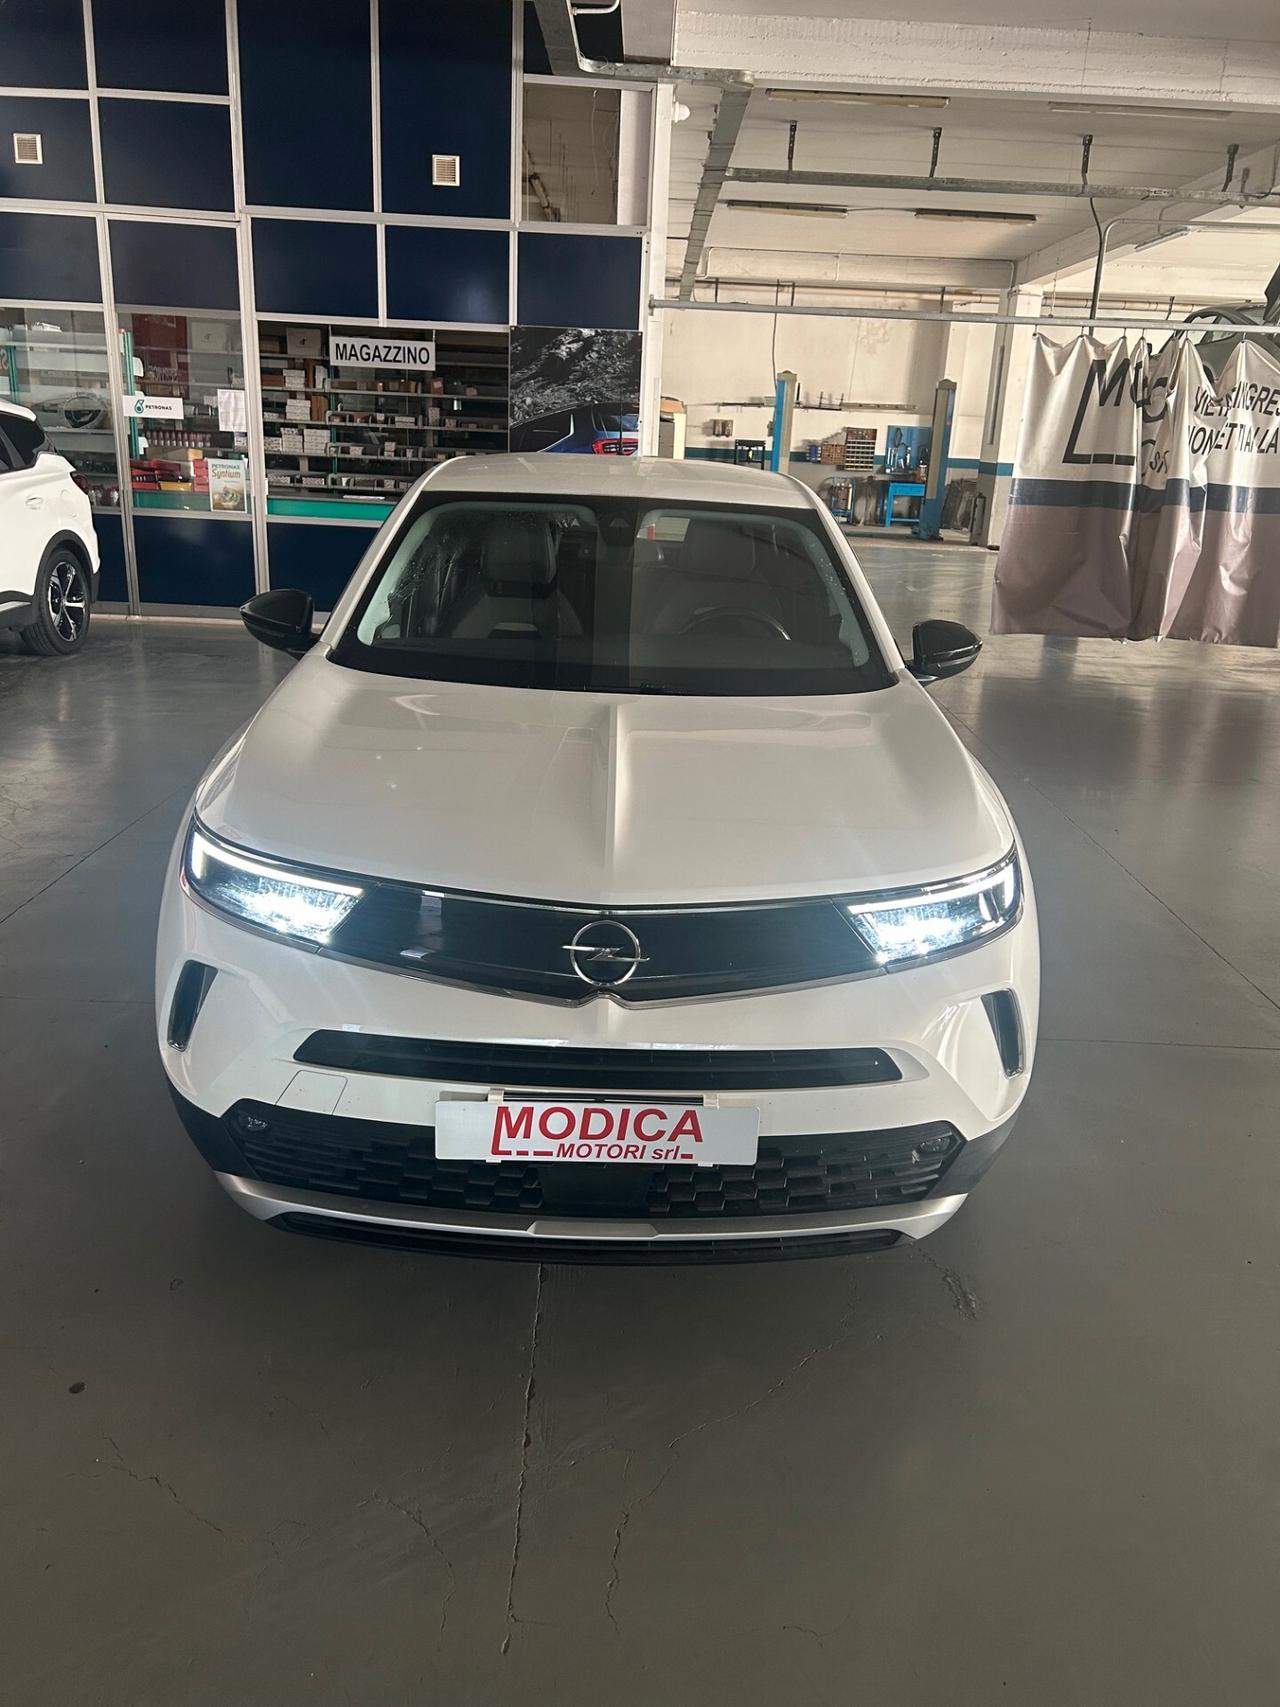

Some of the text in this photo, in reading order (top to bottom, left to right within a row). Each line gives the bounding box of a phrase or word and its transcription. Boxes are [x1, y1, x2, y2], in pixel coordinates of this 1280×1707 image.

[335, 342, 430, 365] MAGAZZINO
[211, 469, 241, 480] Syntium
[491, 1106, 703, 1155] MODICA
[556, 1143, 646, 1159] MOTORI
